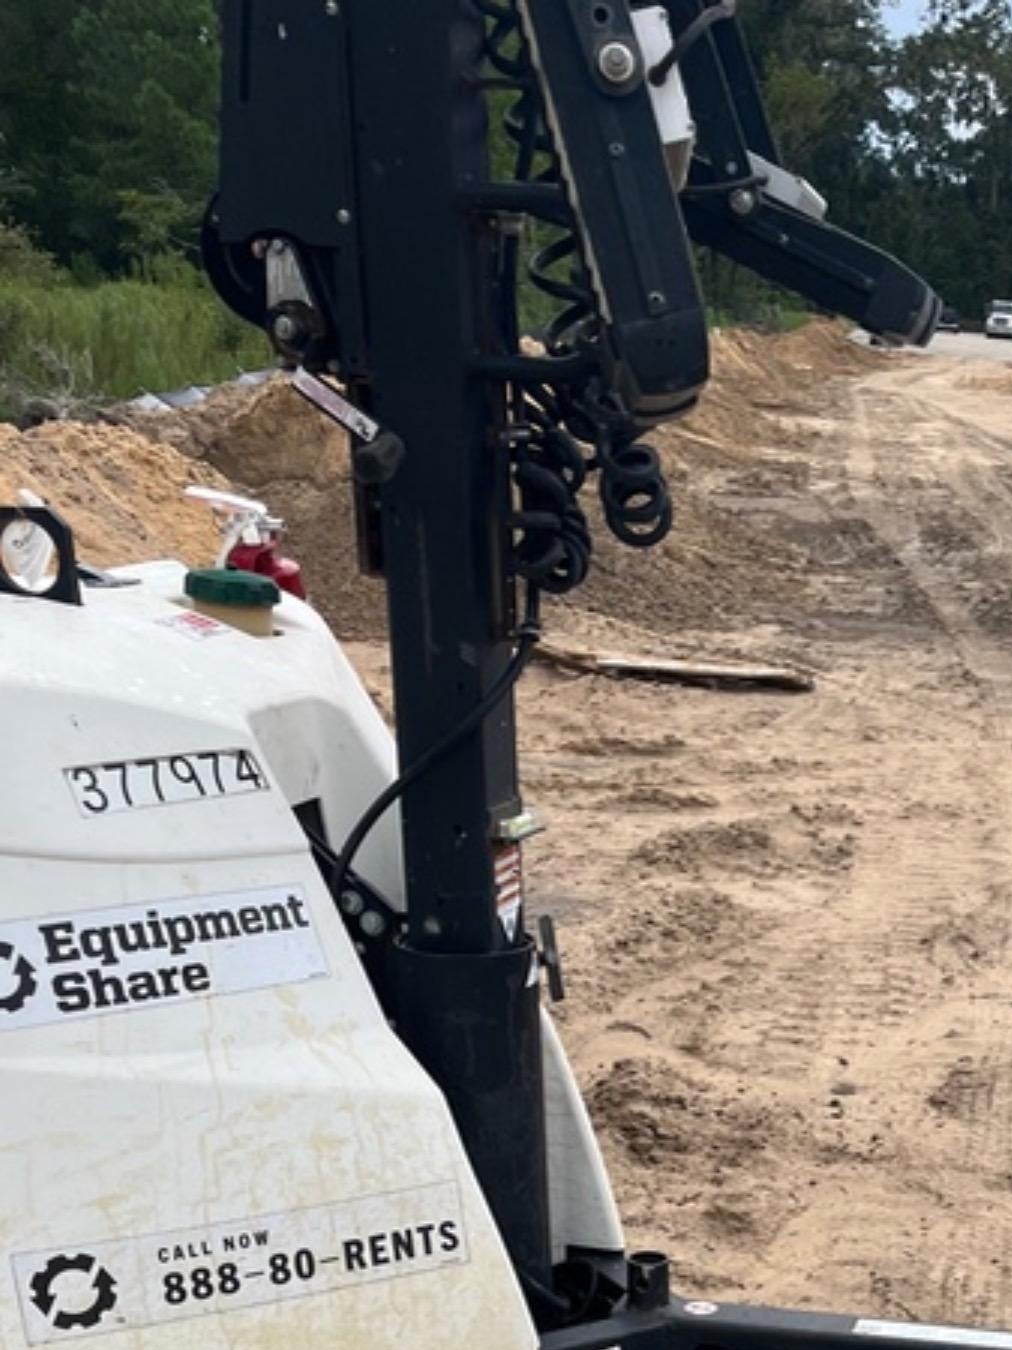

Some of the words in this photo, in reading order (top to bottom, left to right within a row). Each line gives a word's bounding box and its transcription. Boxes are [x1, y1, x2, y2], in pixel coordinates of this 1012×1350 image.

[73, 750, 260, 813] 377974
[38, 895, 309, 966] Equipment
[52, 961, 210, 1013] Share
[158, 1241, 212, 1263] CALL
[224, 1230, 269, 1251] NOW
[162, 1221, 460, 1305] 888-80-RENTS
